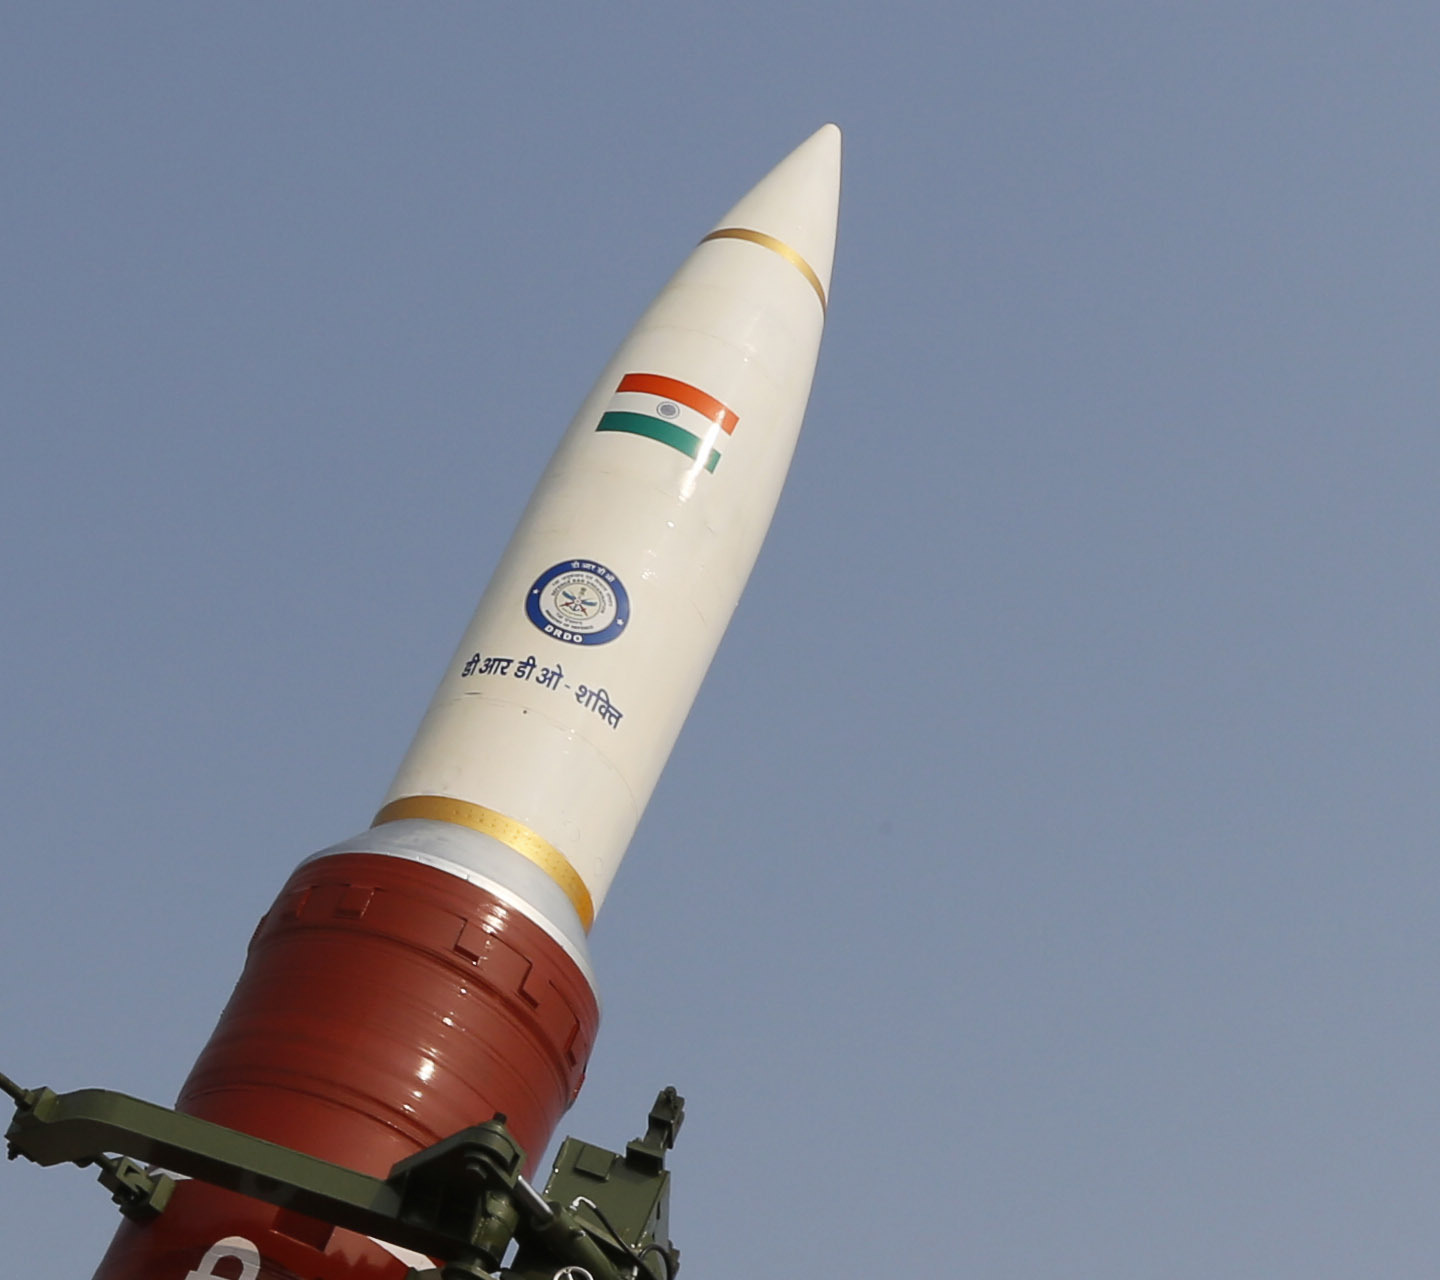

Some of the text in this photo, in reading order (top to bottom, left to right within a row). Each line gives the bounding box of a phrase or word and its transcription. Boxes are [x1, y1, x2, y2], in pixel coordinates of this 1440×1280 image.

[544, 625, 583, 643] DRDO
[461, 653, 480, 677] डी
[479, 657, 514, 676] आर
[514, 655, 536, 681] डी
[536, 664, 564, 691] ओ
[575, 684, 623, 730] शक्ति
